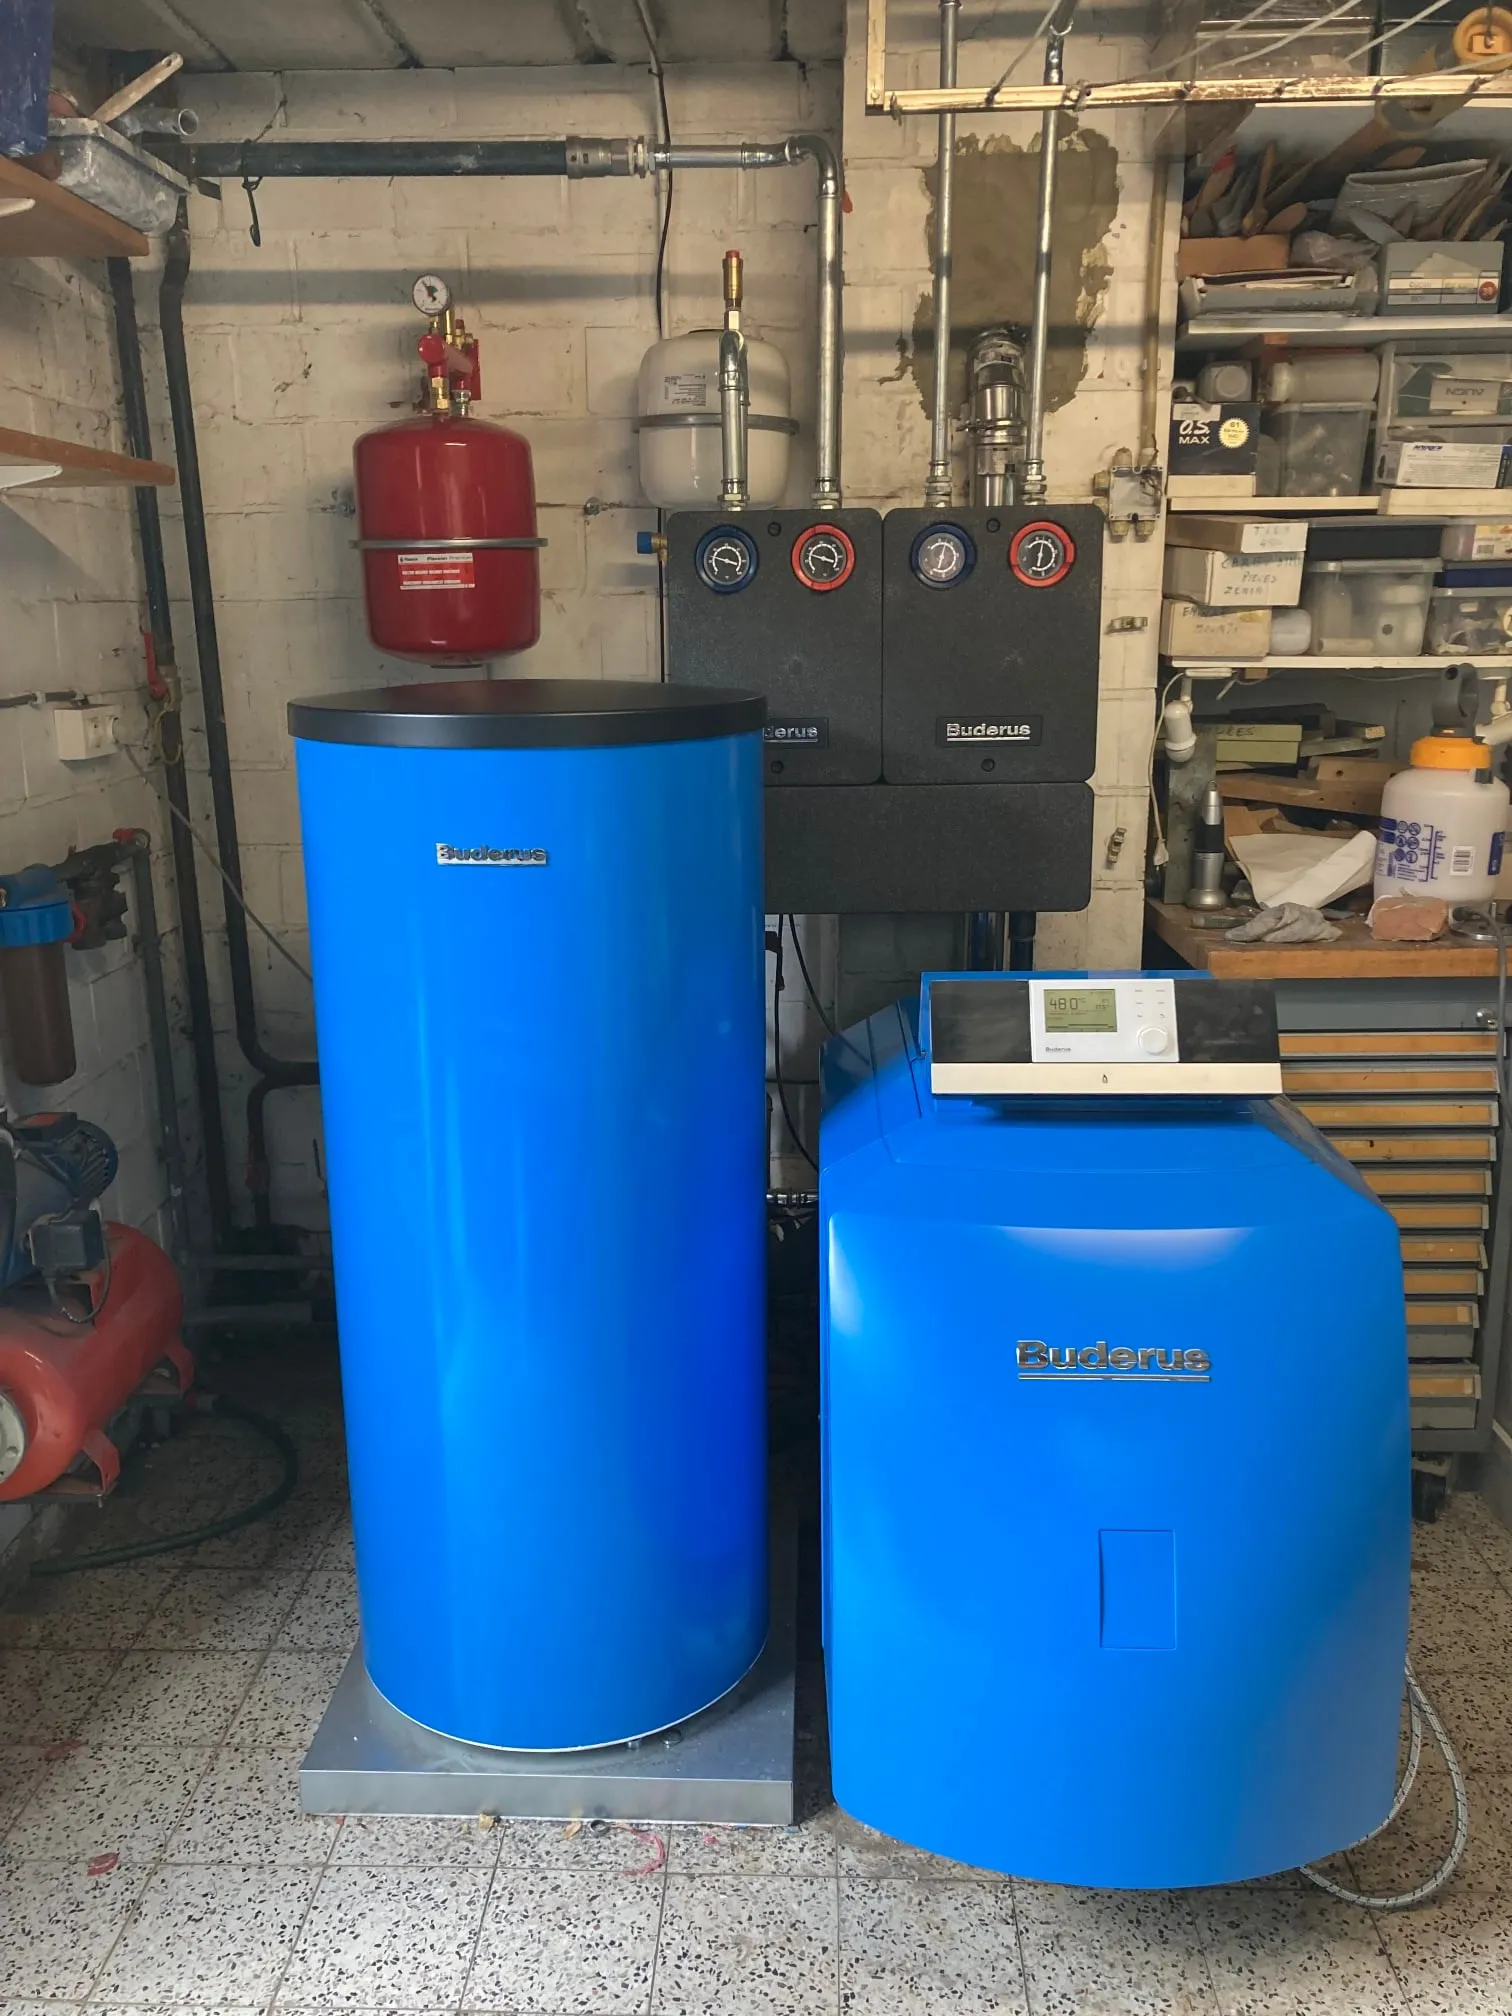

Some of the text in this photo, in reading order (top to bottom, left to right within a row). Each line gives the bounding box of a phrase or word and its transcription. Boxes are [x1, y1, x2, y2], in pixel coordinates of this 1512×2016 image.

[1179, 436, 1210, 445] MAX
[764, 724, 818, 739] derus
[946, 722, 1031, 738] Buderus
[435, 842, 547, 862] Buderus
[1015, 1340, 1212, 1372] Buderus
